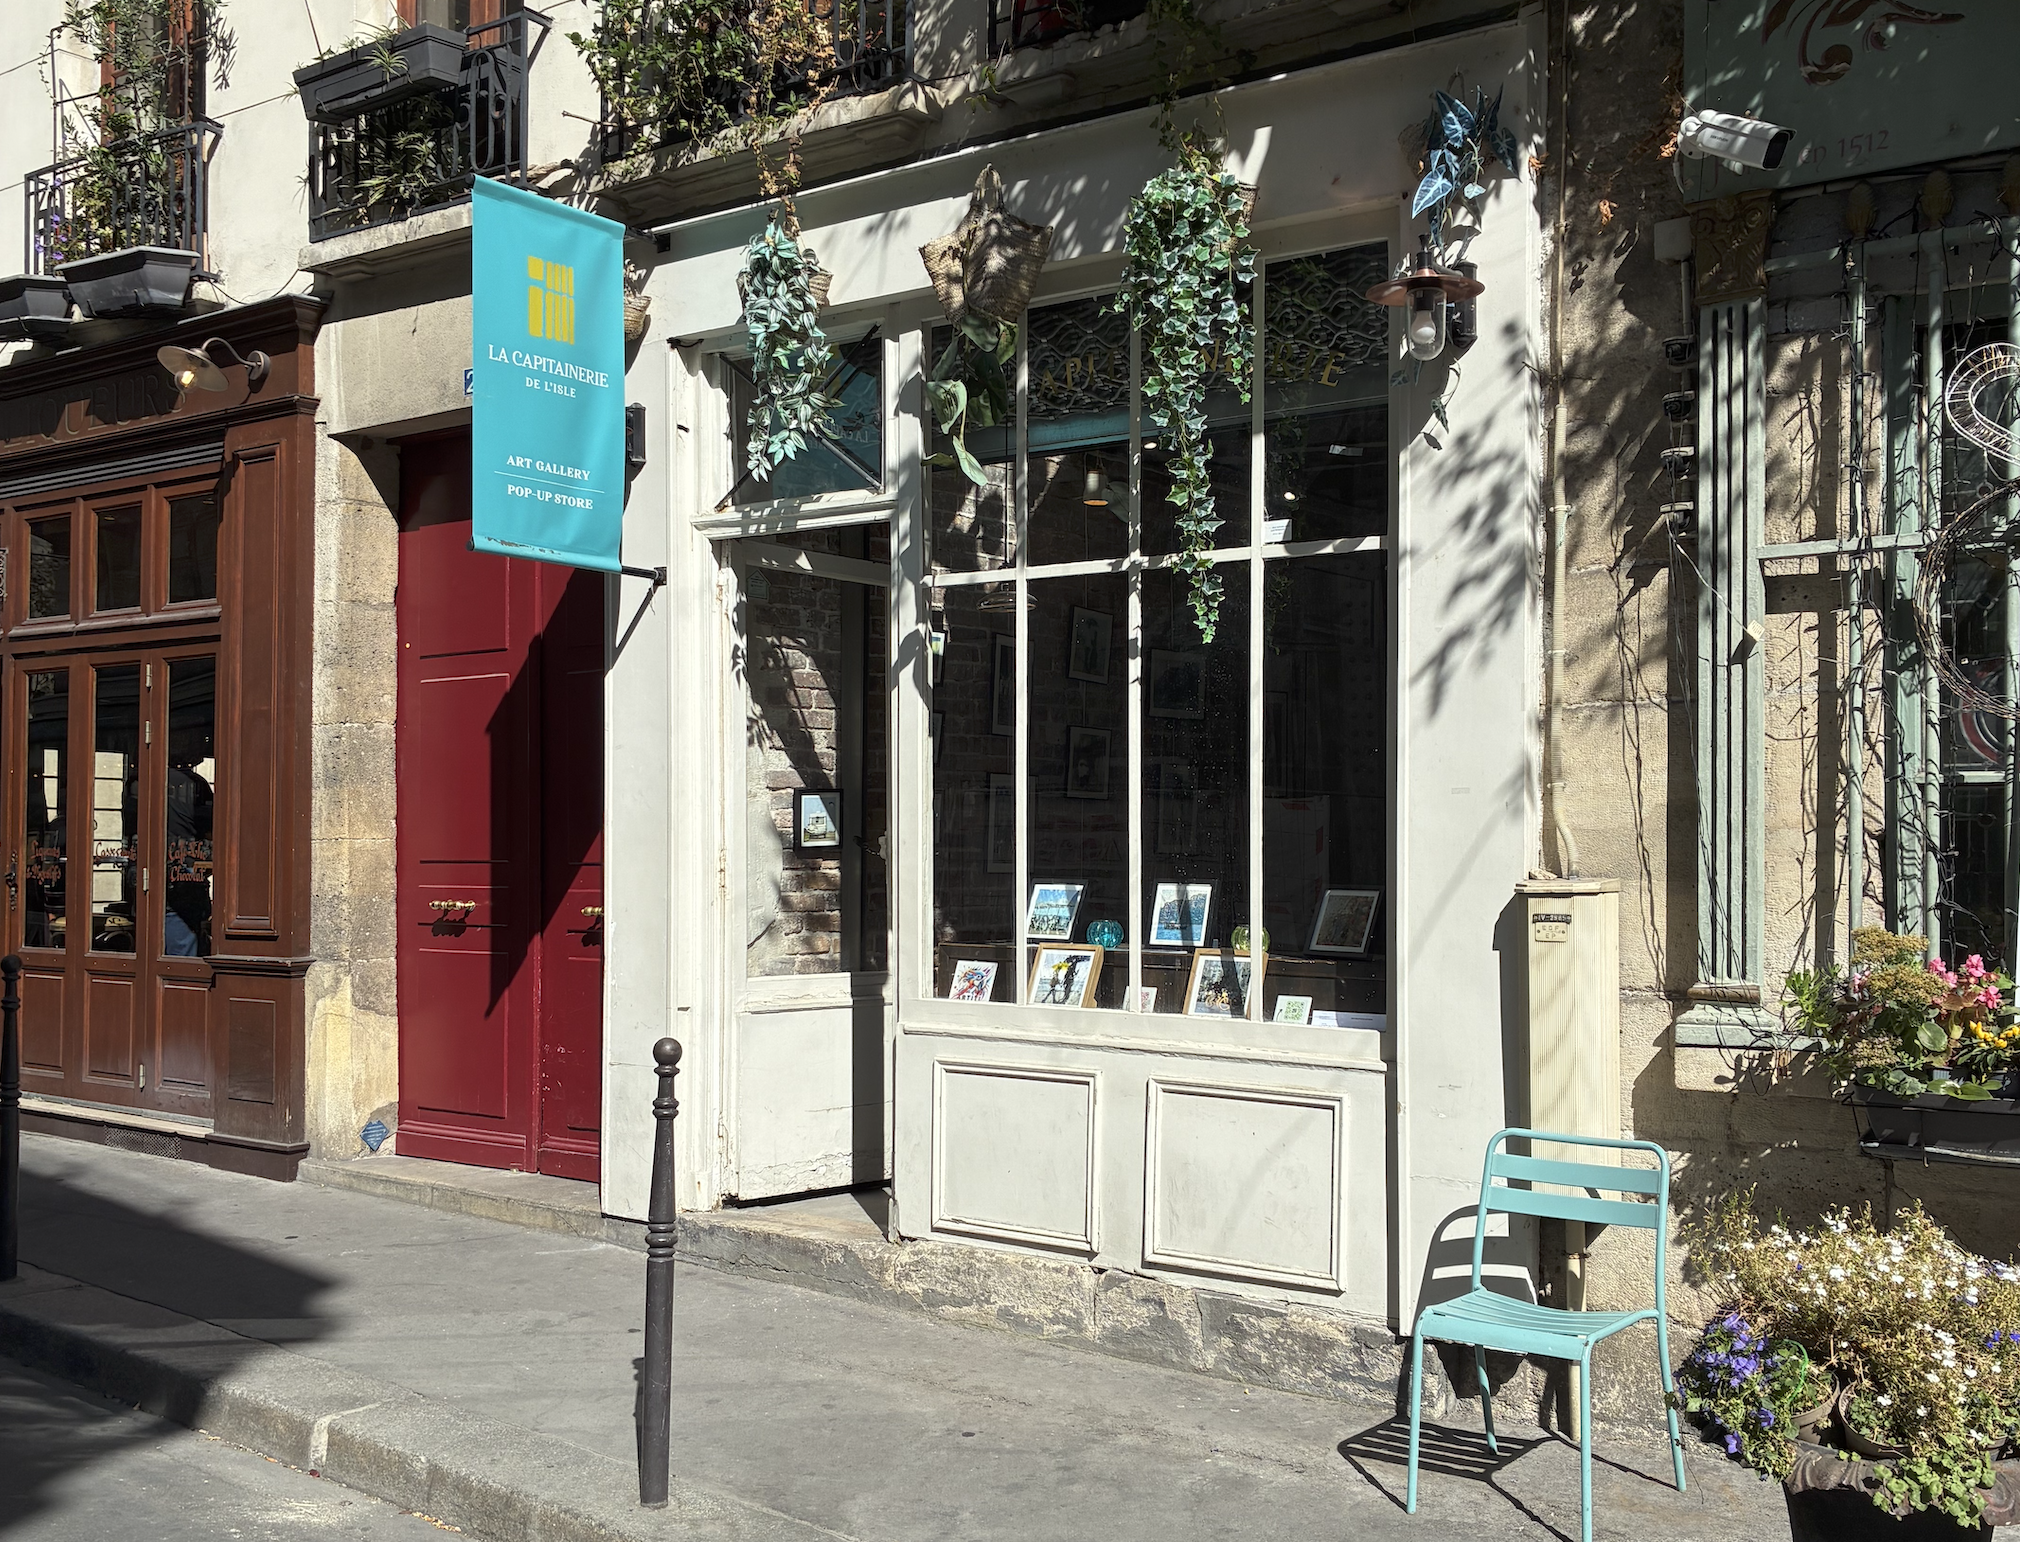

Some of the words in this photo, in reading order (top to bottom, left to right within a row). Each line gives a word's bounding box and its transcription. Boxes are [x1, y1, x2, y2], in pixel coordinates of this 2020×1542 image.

[1838, 130, 1890, 164] 1512
[488, 343, 509, 364] LA
[512, 350, 609, 388] CAPITAINERIE
[525, 377, 541, 390] DE
[544, 381, 577, 398] L'ISLE
[506, 455, 532, 469] ART
[536, 460, 591, 481] GALLERY
[507, 484, 552, 502] POP-UP
[554, 493, 593, 510] STORE
